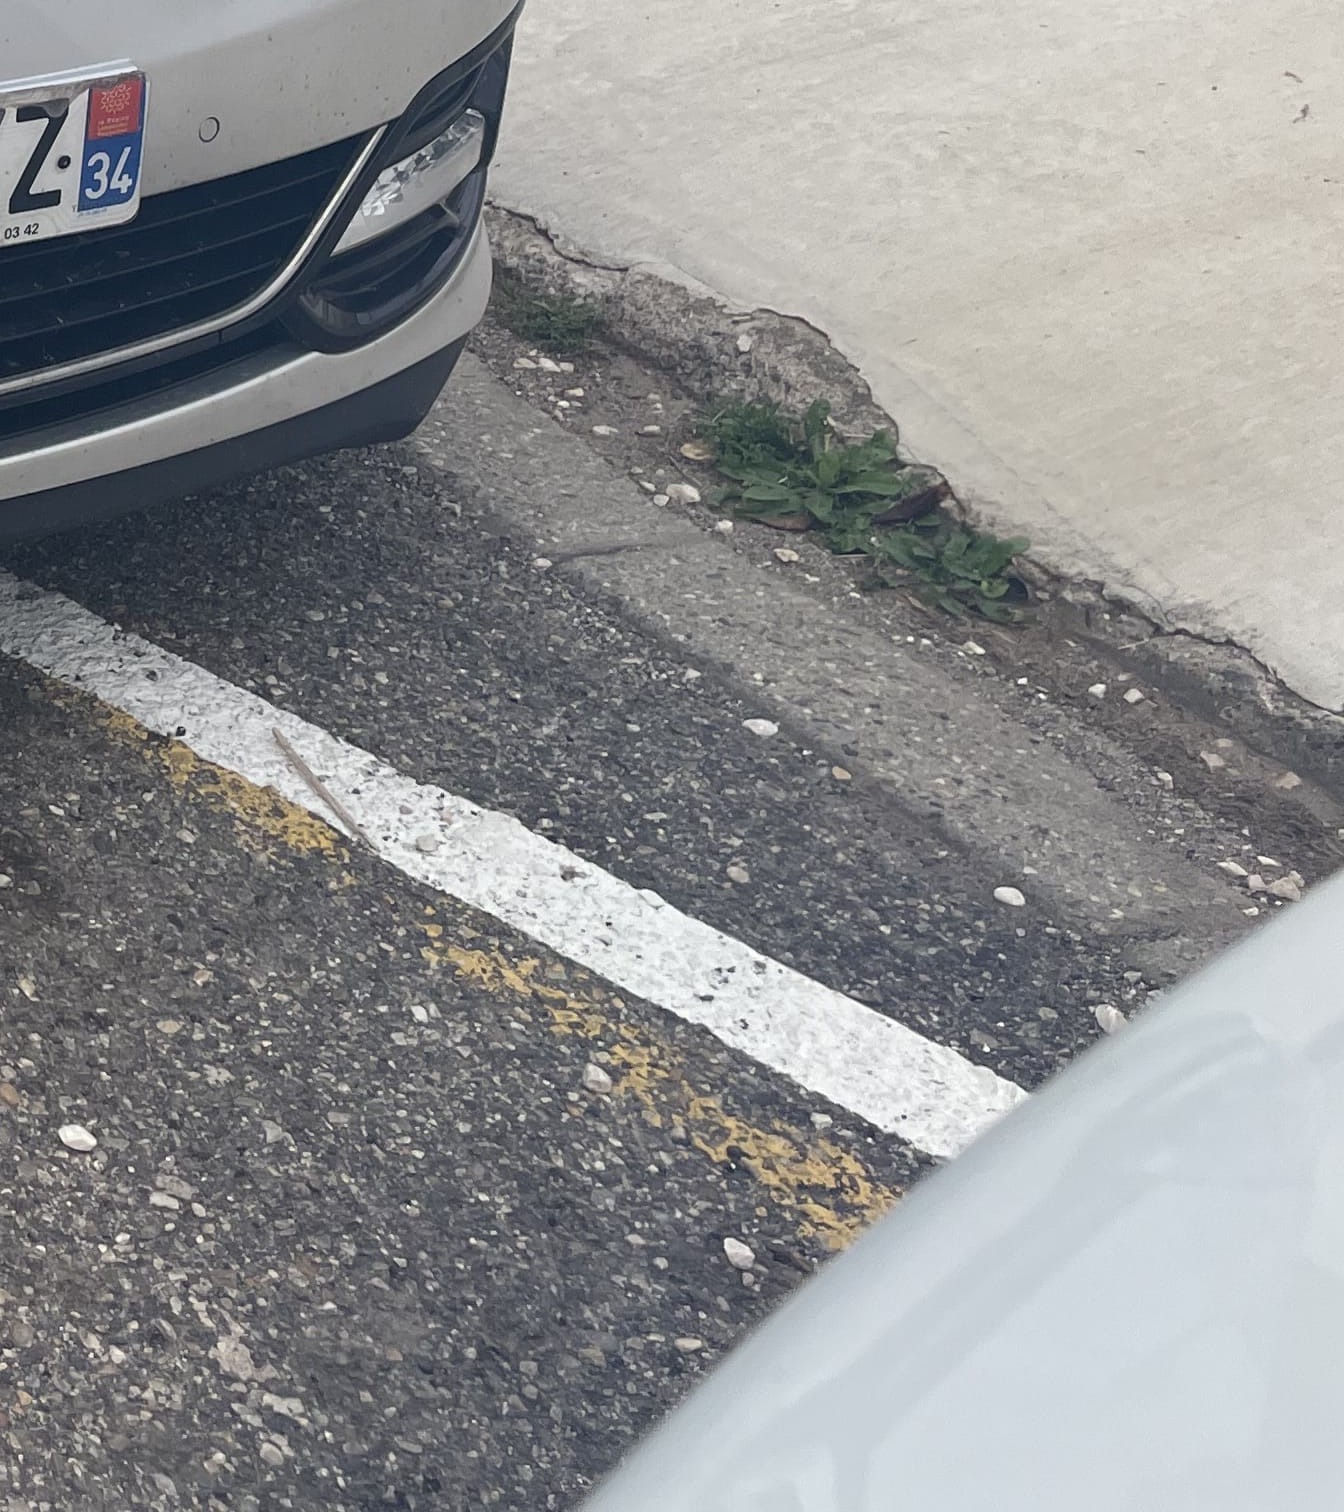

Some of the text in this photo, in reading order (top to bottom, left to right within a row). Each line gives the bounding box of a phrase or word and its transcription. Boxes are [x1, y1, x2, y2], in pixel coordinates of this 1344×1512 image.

[85, 146, 133, 200] 34
[4, 226, 20, 240] 03
[23, 223, 40, 236] 42
